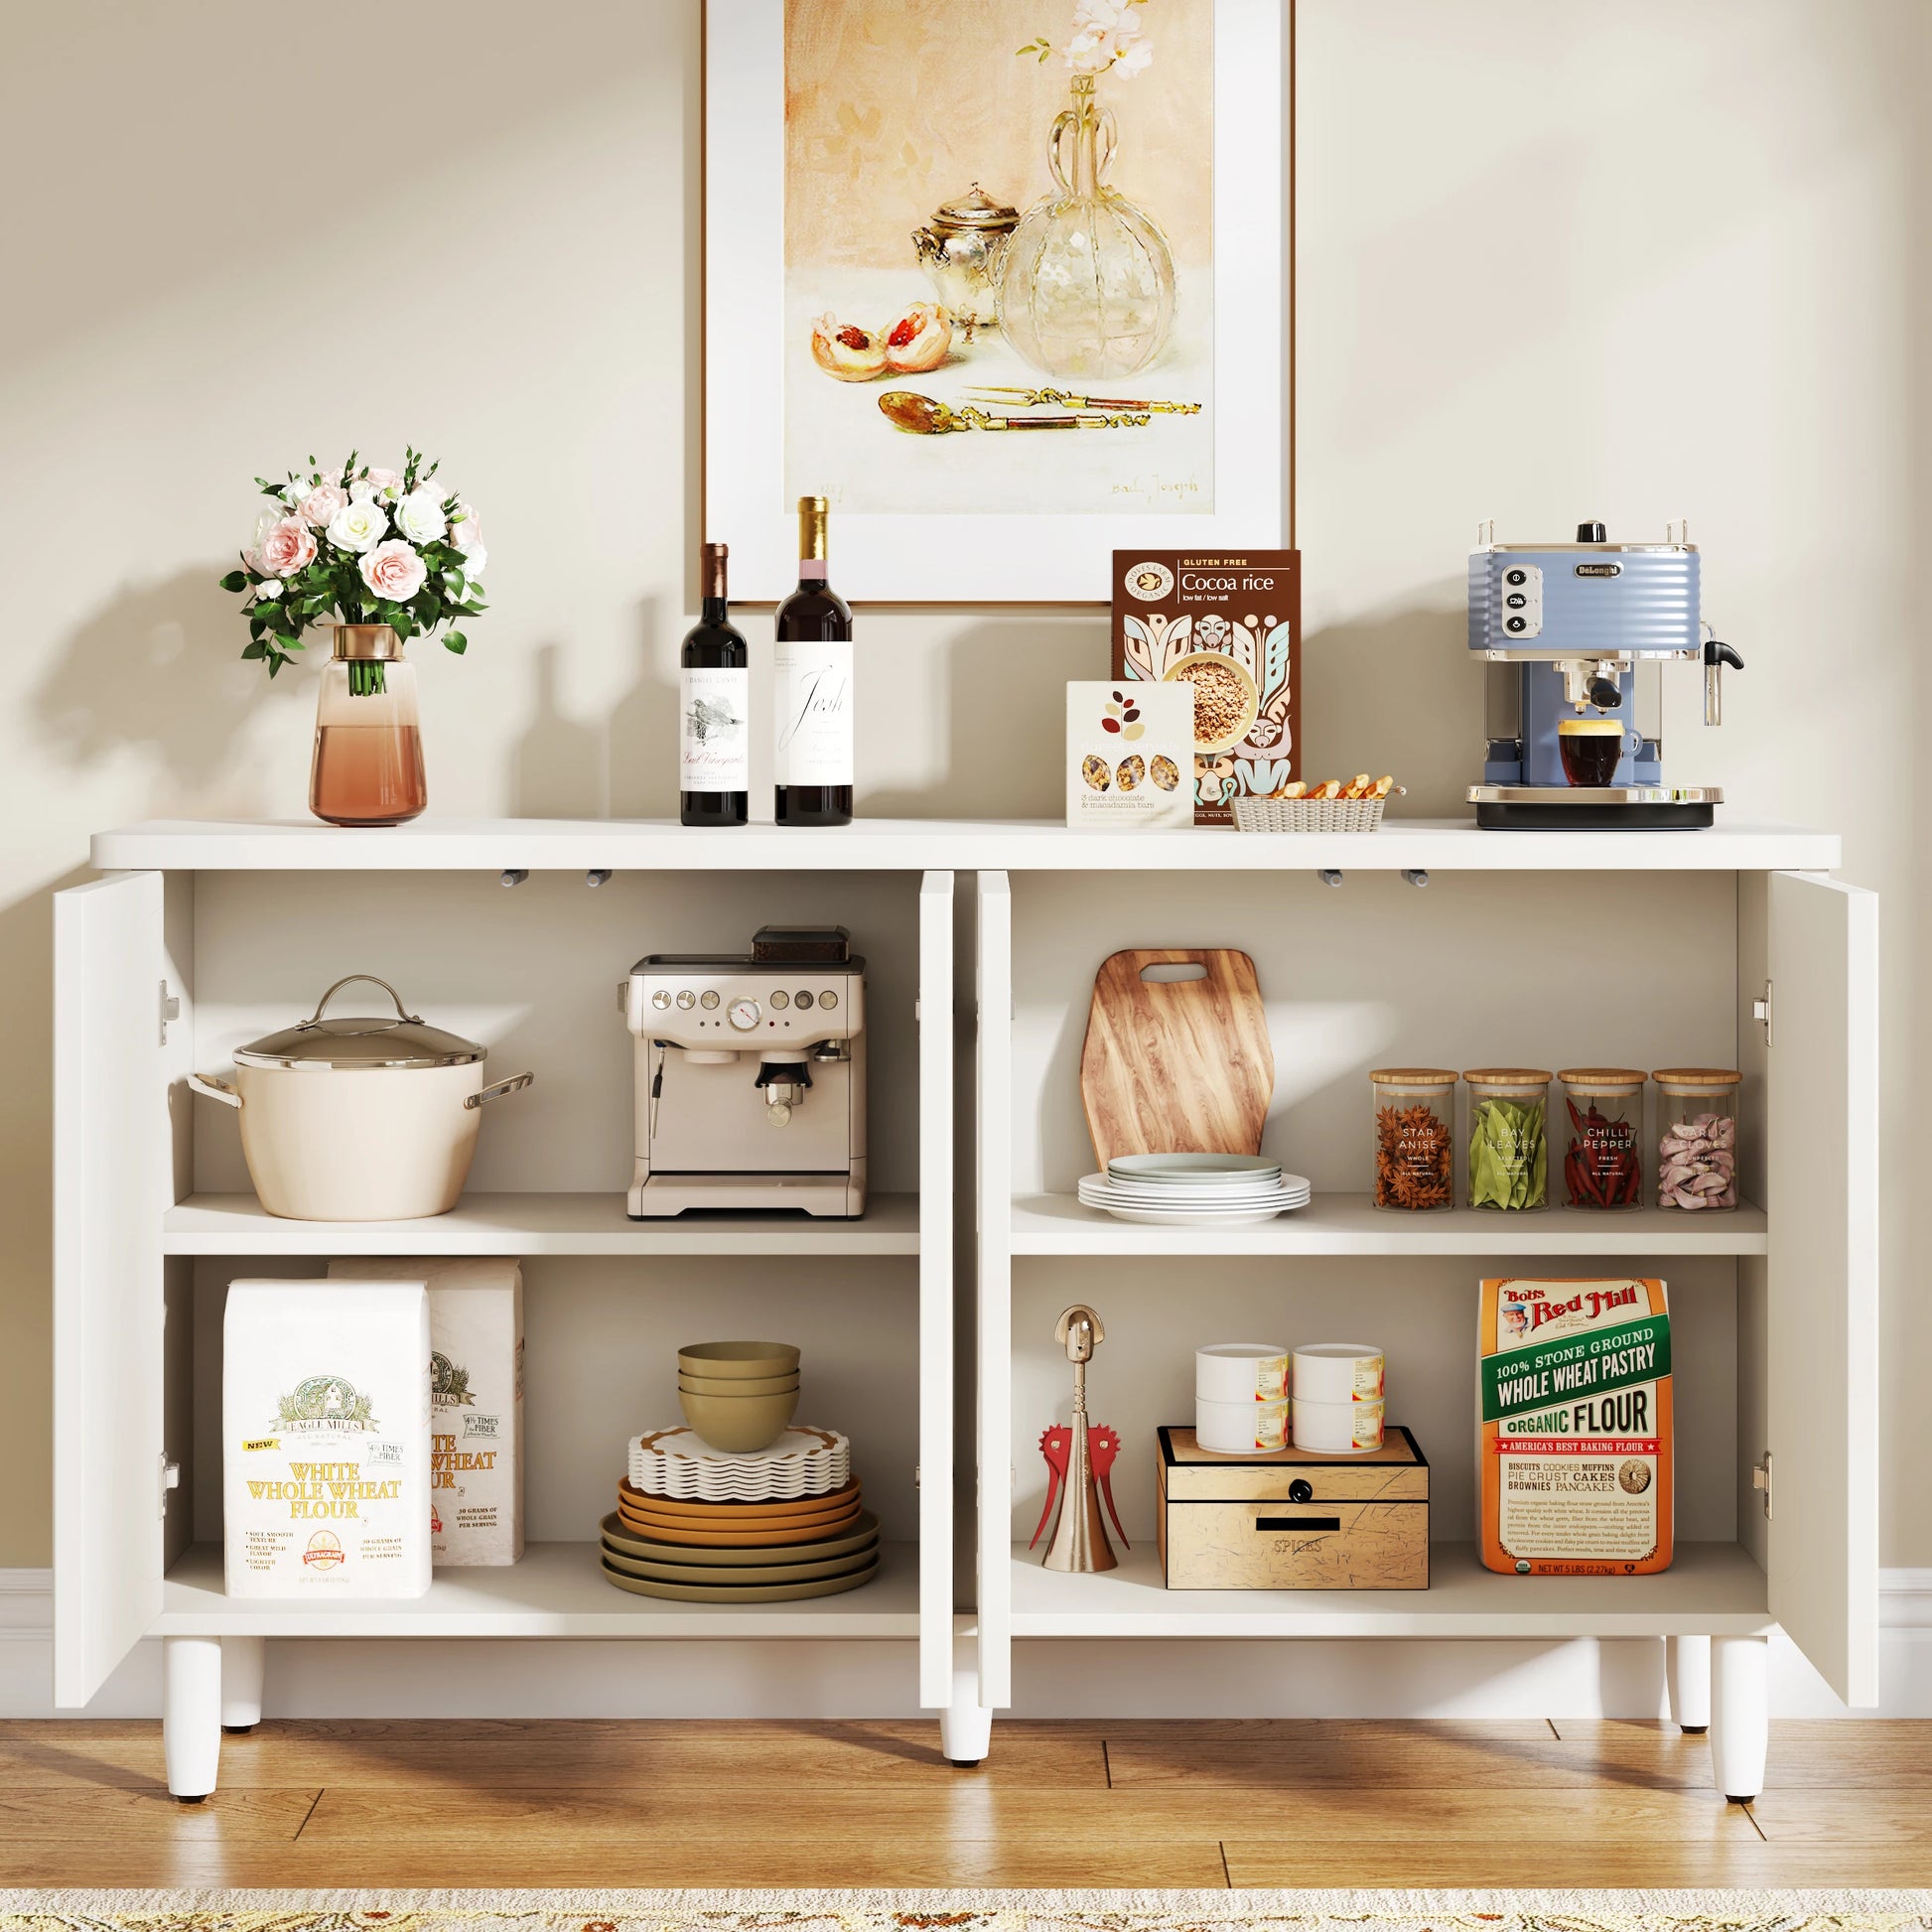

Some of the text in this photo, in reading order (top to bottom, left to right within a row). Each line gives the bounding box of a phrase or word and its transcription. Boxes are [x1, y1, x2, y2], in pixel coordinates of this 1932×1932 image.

[1579, 566, 1617, 575] DeLonghi
[1181, 573, 1275, 591] Cocoa rice
[1403, 1128, 1434, 1137] STAR
[1501, 1128, 1525, 1137] BAY
[1587, 1128, 1628, 1137] CHILLI
[1681, 1128, 1726, 1137] GARLIC
[1399, 1140, 1437, 1149] ANISE
[1489, 1140, 1535, 1149] LEAVES
[1584, 1140, 1632, 1150] PEPPER
[1679, 1140, 1727, 1149] CLOVES
[1504, 1290, 1546, 1303] Bob's
[1531, 1295, 1584, 1331] Red
[1586, 1286, 1638, 1318] Mill
[1496, 1327, 1654, 1379] 100% STONE GROUND
[1497, 1342, 1656, 1408] WHOLE WHEAT PASTRY
[432, 1394, 456, 1404] ILLS
[1507, 1390, 1648, 1434] ORGANIC FLOUR
[290, 1420, 322, 1432] EAGLE
[477, 1417, 498, 1426] TIMES
[247, 1441, 273, 1449] NEW
[1509, 1443, 1644, 1451] AMERICA'S BEST BAKING FLOUR
[289, 1461, 360, 1481] WHITE
[1508, 1471, 1615, 1481] PIE CRUST CAKES
[246, 1480, 402, 1500] WHOLE WHEAT
[1508, 1481, 1615, 1491] BROWNIES PANCAKES
[290, 1500, 359, 1519] FLOUR
[1274, 1539, 1322, 1553] SPICES
[1587, 1566, 1616, 1575] (2.27kg)
